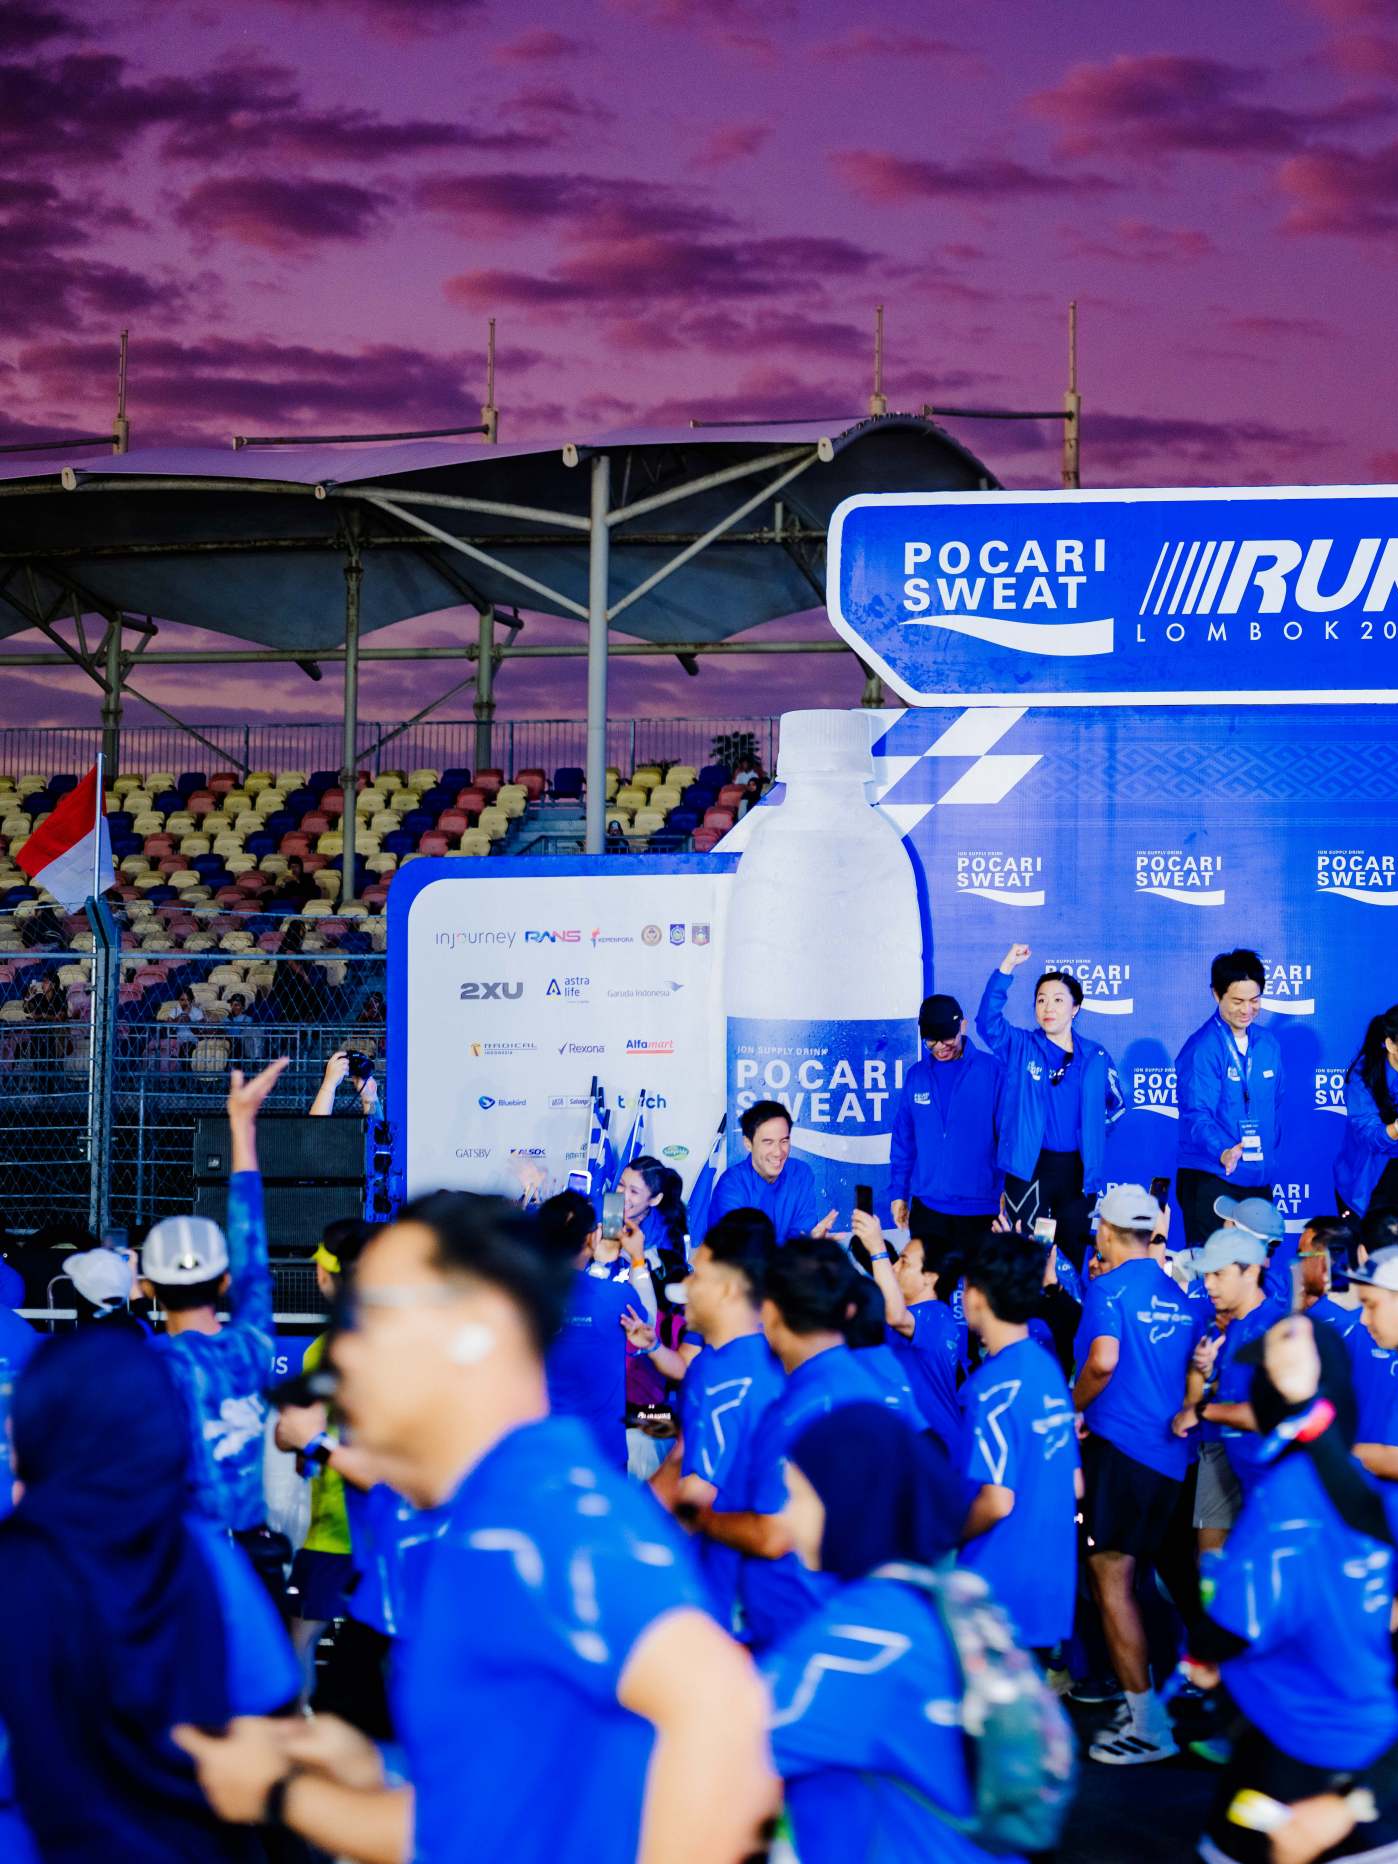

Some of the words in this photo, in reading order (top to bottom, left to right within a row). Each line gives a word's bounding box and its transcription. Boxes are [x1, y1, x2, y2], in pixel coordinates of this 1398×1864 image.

[904, 539, 1105, 575] POCARI
[904, 575, 1087, 611] SWEAT
[1137, 621, 1339, 643] LOMBOK
[958, 857, 1041, 871] POCARI
[1137, 856, 1221, 871] POCARI
[957, 873, 1033, 887] SWEAT
[1136, 872, 1213, 886] SWEAT
[1318, 872, 1395, 886] SWEAT
[525, 930, 582, 943] RANS
[1264, 965, 1311, 980] CARI
[564, 976, 590, 986] astra
[1083, 980, 1121, 994] EAT
[1264, 981, 1303, 995] EAT
[460, 982, 524, 1000] 2XU
[564, 987, 581, 997] life
[569, 1043, 605, 1054] Rexona
[626, 1039, 674, 1049] Alfamart
[736, 1045, 754, 1054] ION
[758, 1046, 794, 1055] SUPPLY
[796, 1047, 829, 1056] DRINK
[737, 1059, 903, 1089] POCARI
[1134, 1074, 1177, 1088] POC
[456, 1149, 491, 1160] GATSBY
[1272, 1184, 1310, 1198] ARI
